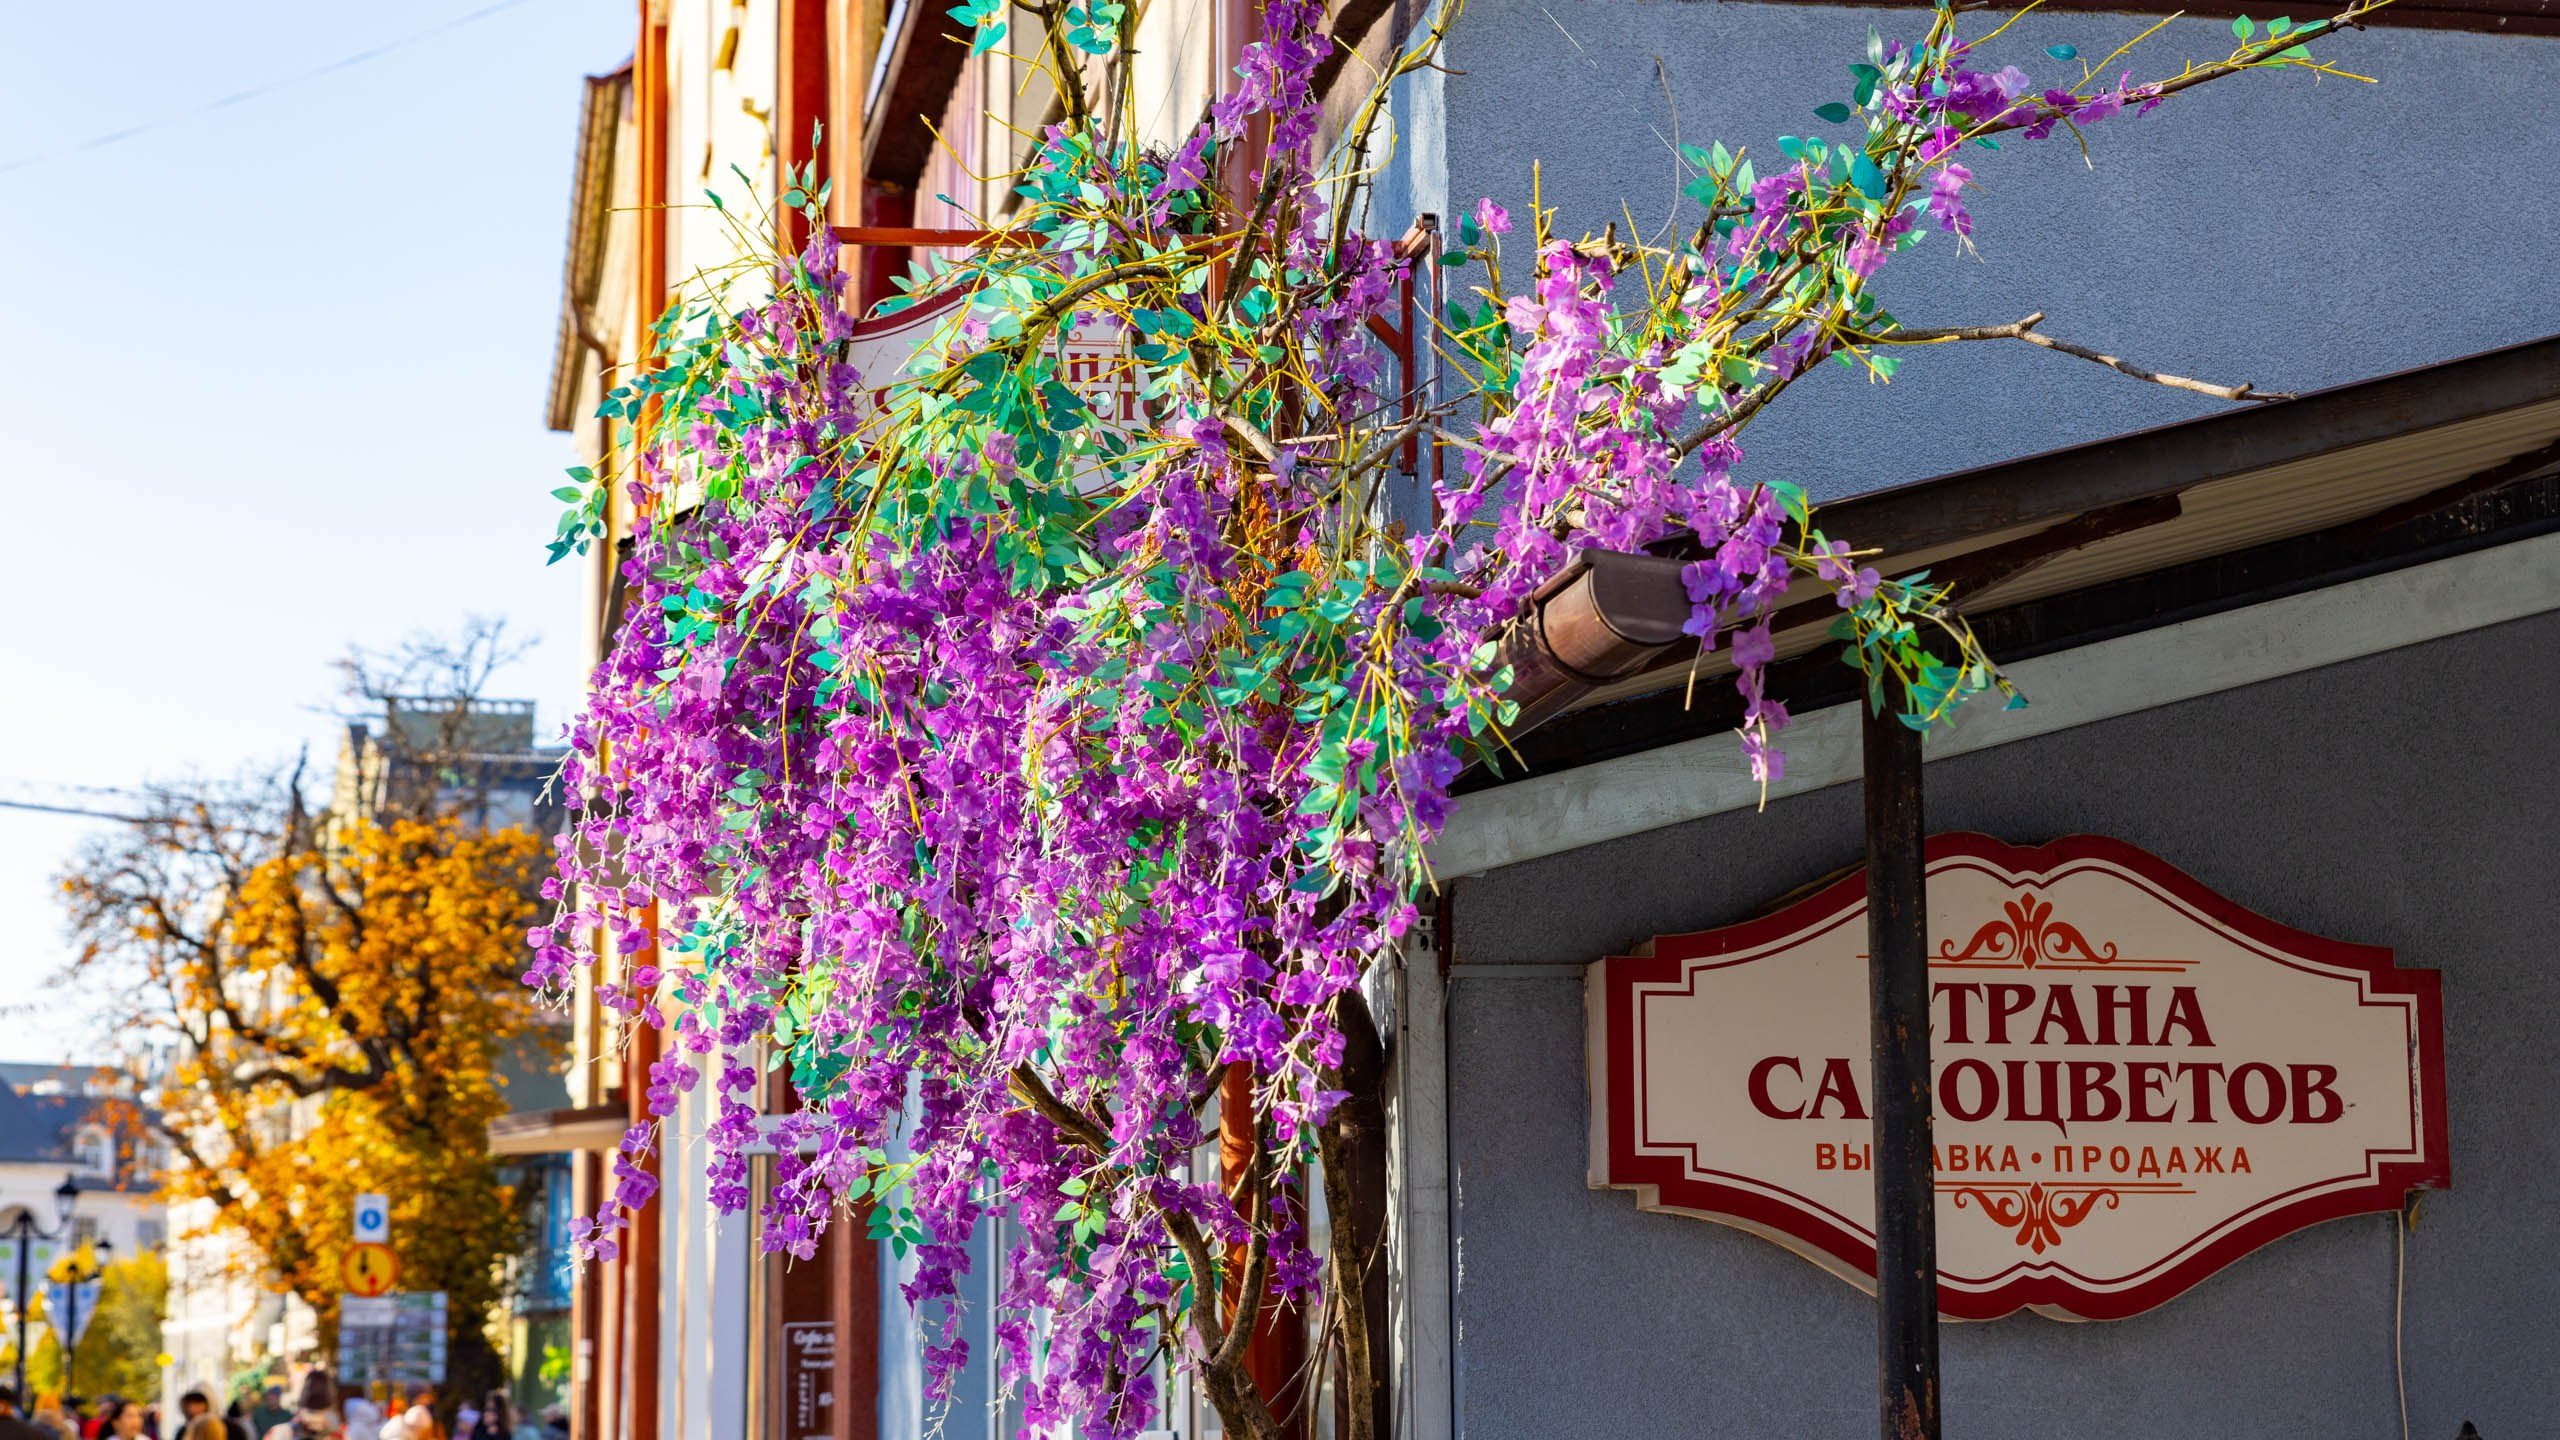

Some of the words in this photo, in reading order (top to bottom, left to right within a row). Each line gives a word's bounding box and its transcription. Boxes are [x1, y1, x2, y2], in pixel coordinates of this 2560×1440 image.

[1929, 982, 2216, 1047] ТРАНА
[1748, 1056, 2344, 1139] САОЦВЕТОВ
[1816, 1143, 2021, 1172] ВЫАВКА
[2054, 1145, 2252, 1178] ПРОДАЖА
